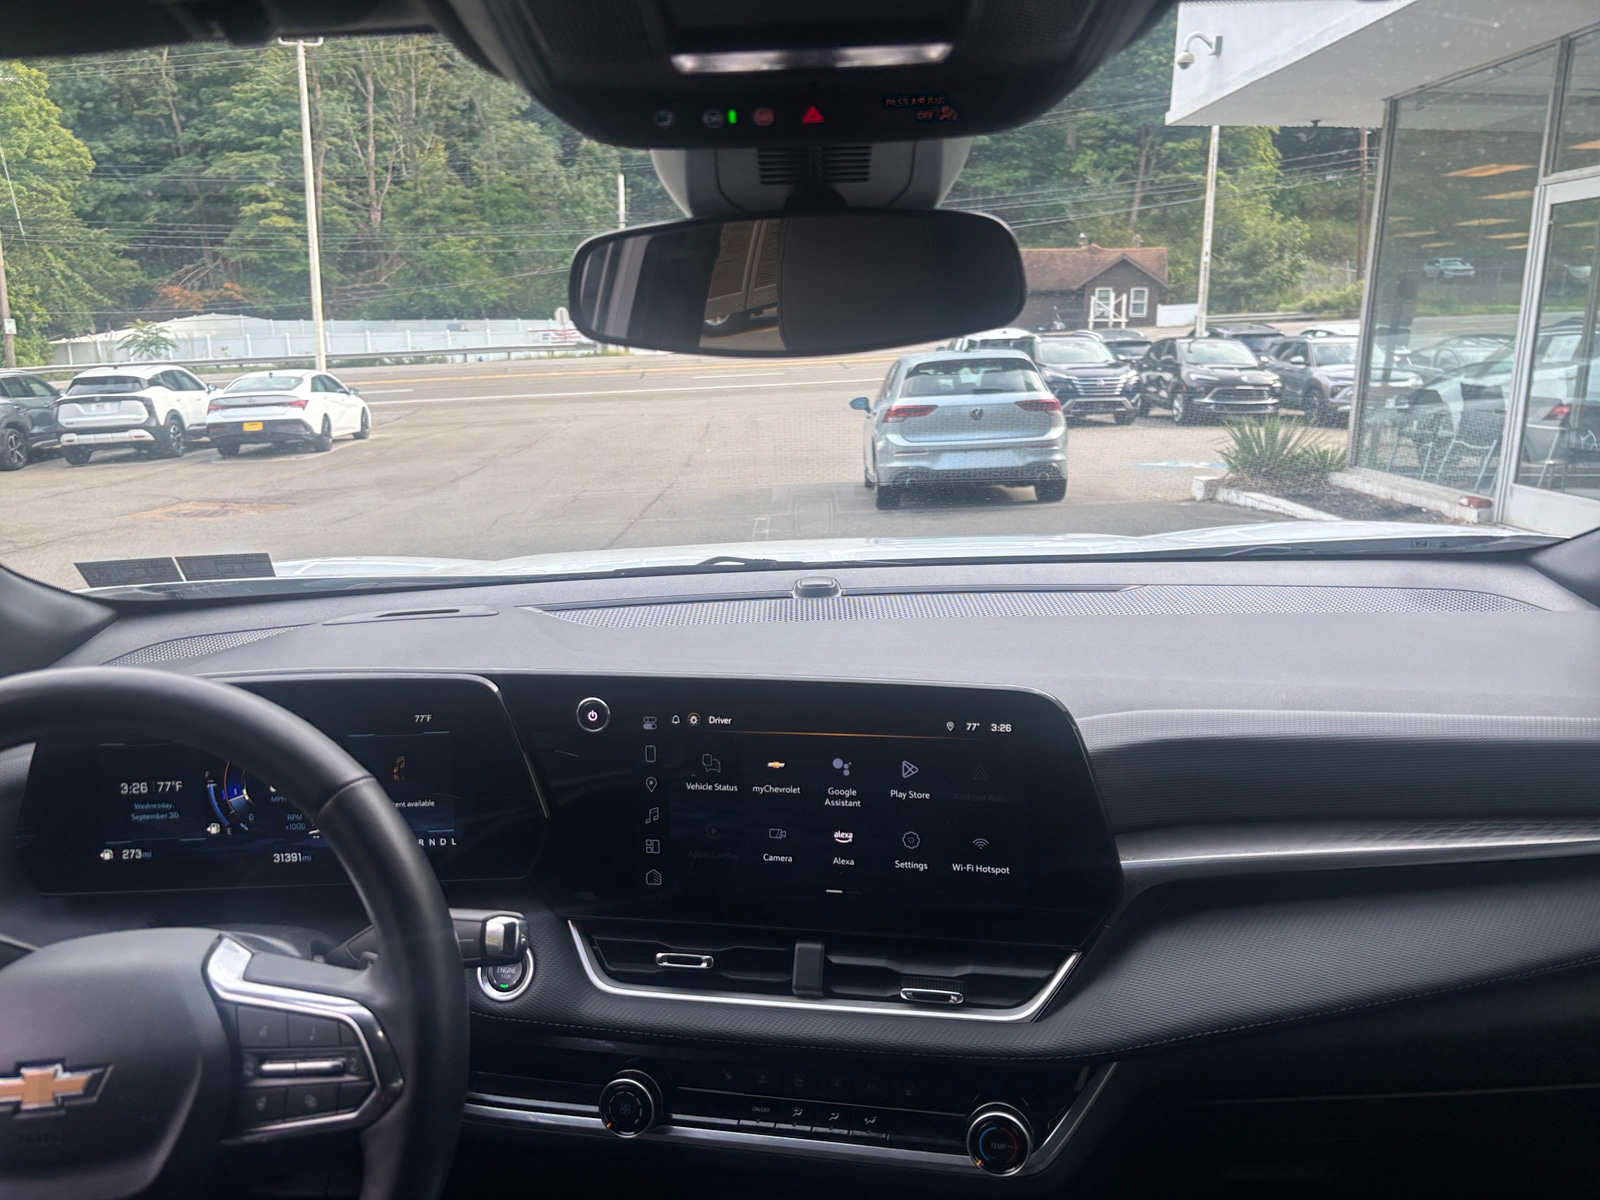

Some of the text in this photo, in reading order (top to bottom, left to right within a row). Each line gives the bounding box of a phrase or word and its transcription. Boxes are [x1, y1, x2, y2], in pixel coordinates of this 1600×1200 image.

[708, 715, 733, 725] Driver
[990, 723, 1012, 733] 3:26
[120, 782, 149, 794] 3:26
[686, 782, 738, 792] Vehicle Status
[752, 784, 801, 795] myChevrolet
[827, 787, 857, 798] Google
[890, 789, 930, 800] Play Store
[407, 799, 435, 807] available
[824, 798, 861, 808] Assistant
[131, 813, 168, 822] September
[429, 838, 436, 846] N
[440, 837, 447, 846] D
[451, 837, 457, 846] L
[763, 853, 793, 863] Camera
[832, 856, 855, 866] Alexa
[894, 859, 928, 871] Settings
[952, 863, 1010, 876] Wi-Fi Hotspot
[497, 966, 516, 974] ENGINE
